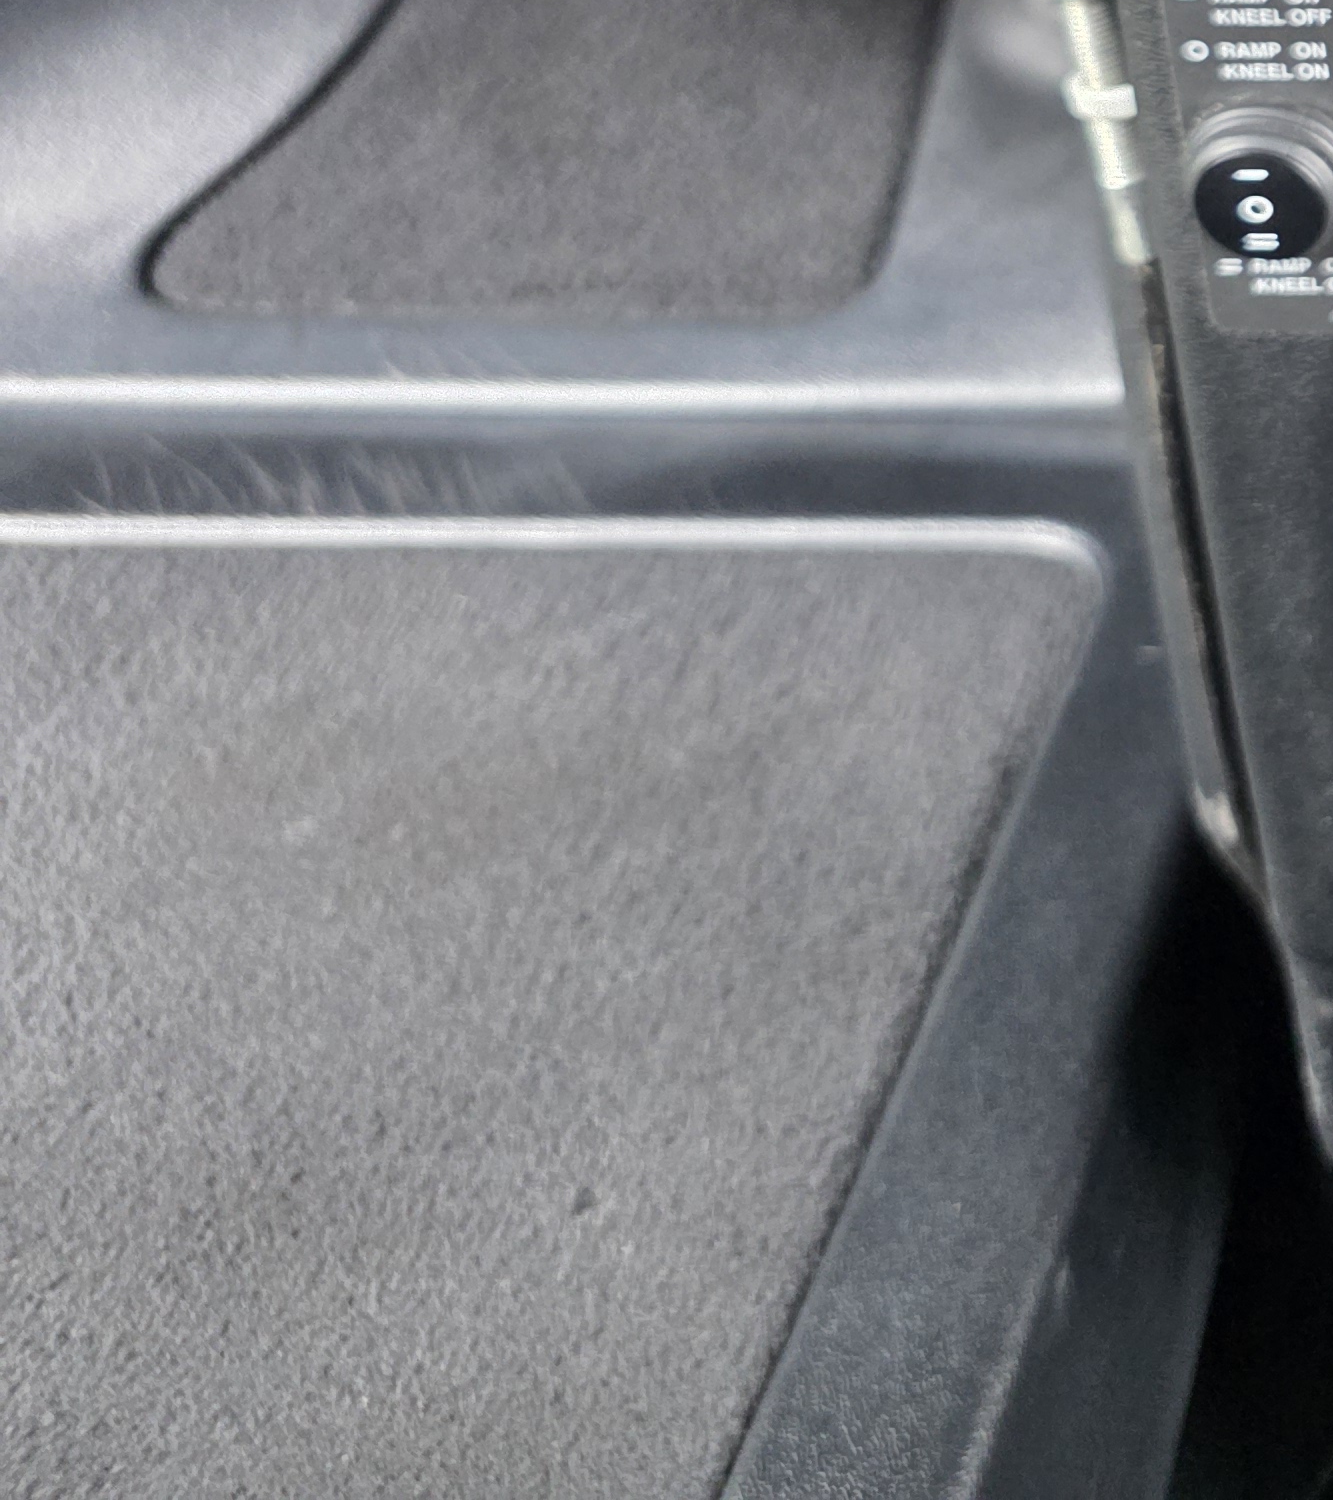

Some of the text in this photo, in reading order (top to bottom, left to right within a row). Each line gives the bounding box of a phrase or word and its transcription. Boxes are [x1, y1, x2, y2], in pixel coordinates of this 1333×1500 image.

[1209, 7, 1332, 27] KNEEL OFF
[1213, 41, 1328, 61] RAMP ON
[1217, 63, 1331, 82] KNEEL ON
[1247, 257, 1312, 276] RAMP
[1250, 277, 1323, 296] KNEEL
